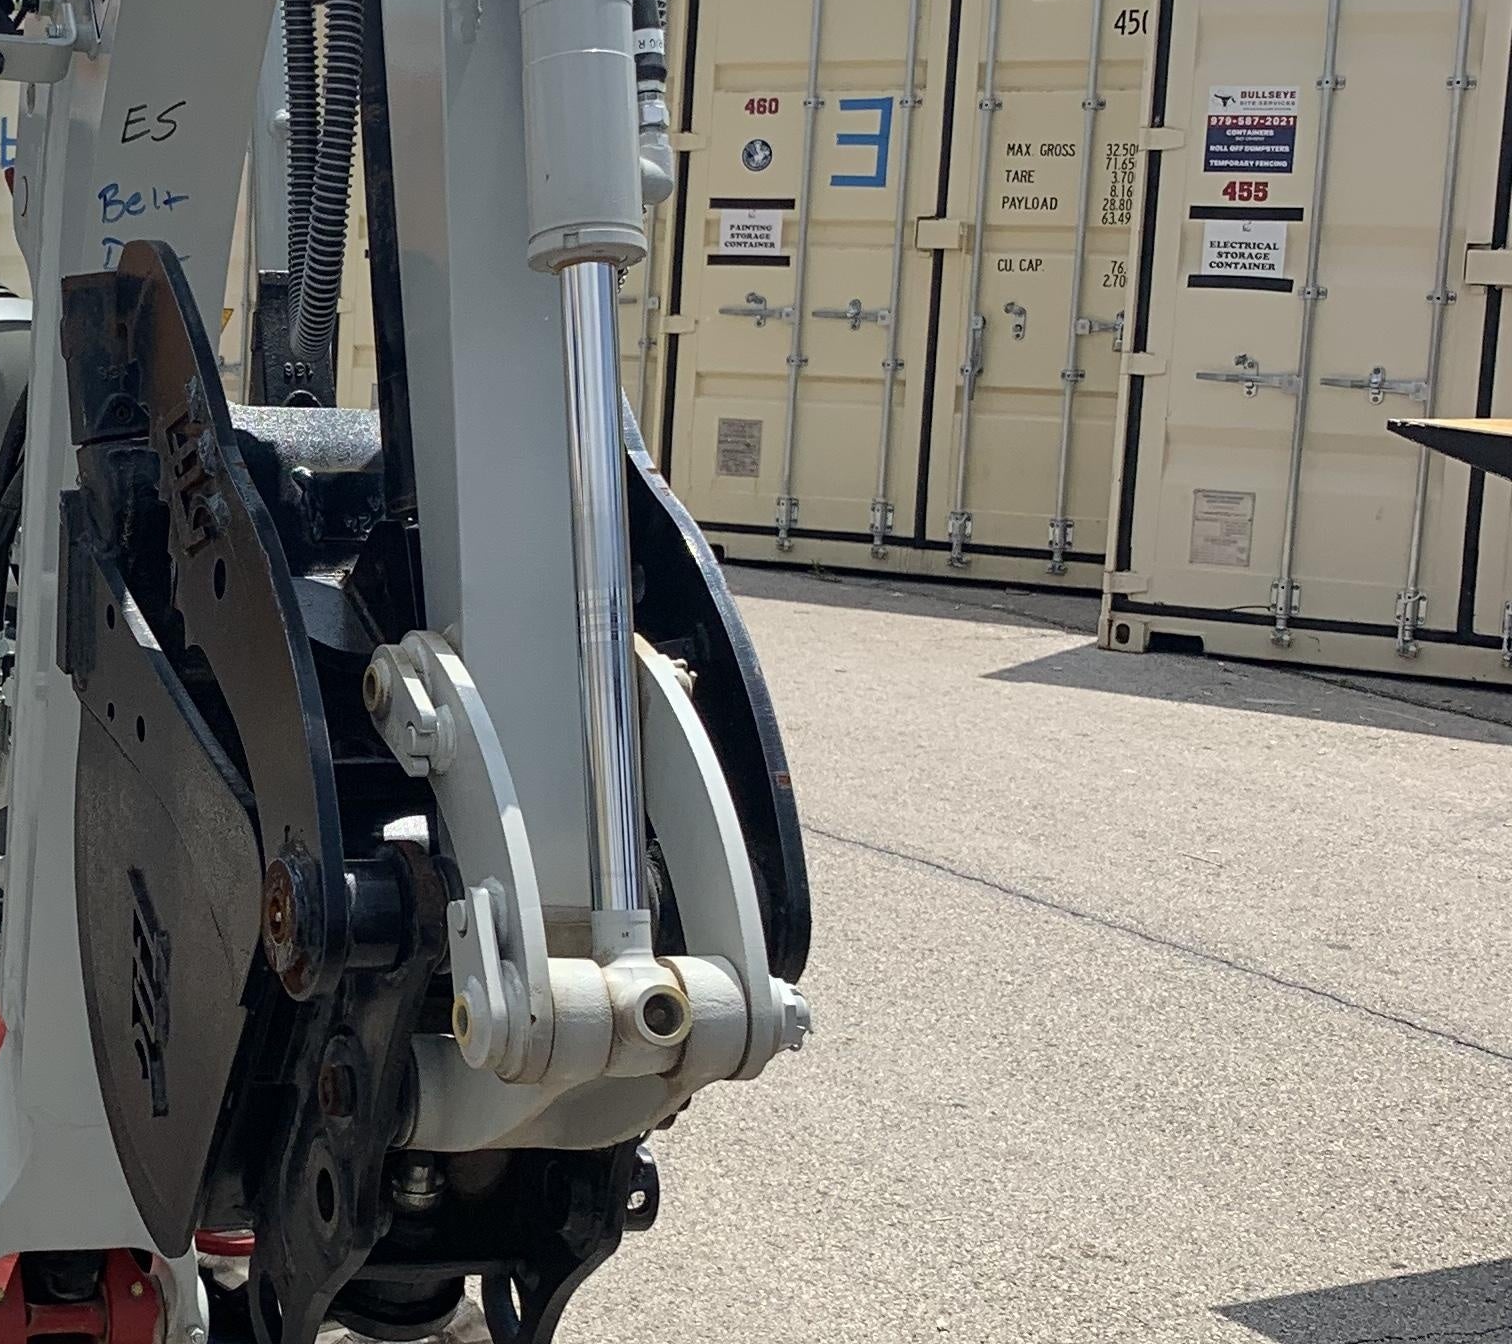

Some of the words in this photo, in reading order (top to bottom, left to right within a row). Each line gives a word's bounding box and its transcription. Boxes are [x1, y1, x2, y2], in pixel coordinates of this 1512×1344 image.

[1240, 90, 1297, 99] BULLSEYE
[744, 98, 779, 114] 460
[1210, 117, 1294, 126] 979-587-2021
[1226, 129, 1274, 137] CONTAINERS
[1040, 143, 1076, 157] GROSS
[1245, 145, 1290, 153] DUMPSTERS
[1209, 159, 1254, 167] TEMPORARY
[1006, 170, 1035, 183] TARE
[1222, 181, 1269, 201] 455
[1002, 196, 1058, 210] PAYLOAD
[729, 224, 772, 232] PAINTING
[730, 232, 771, 240] STORAGE
[724, 241, 776, 249] CONTAINER
[1209, 240, 1279, 251] ELECTRICAL
[1216, 251, 1270, 261] STORAGE
[1208, 260, 1276, 271] CONTAINER
